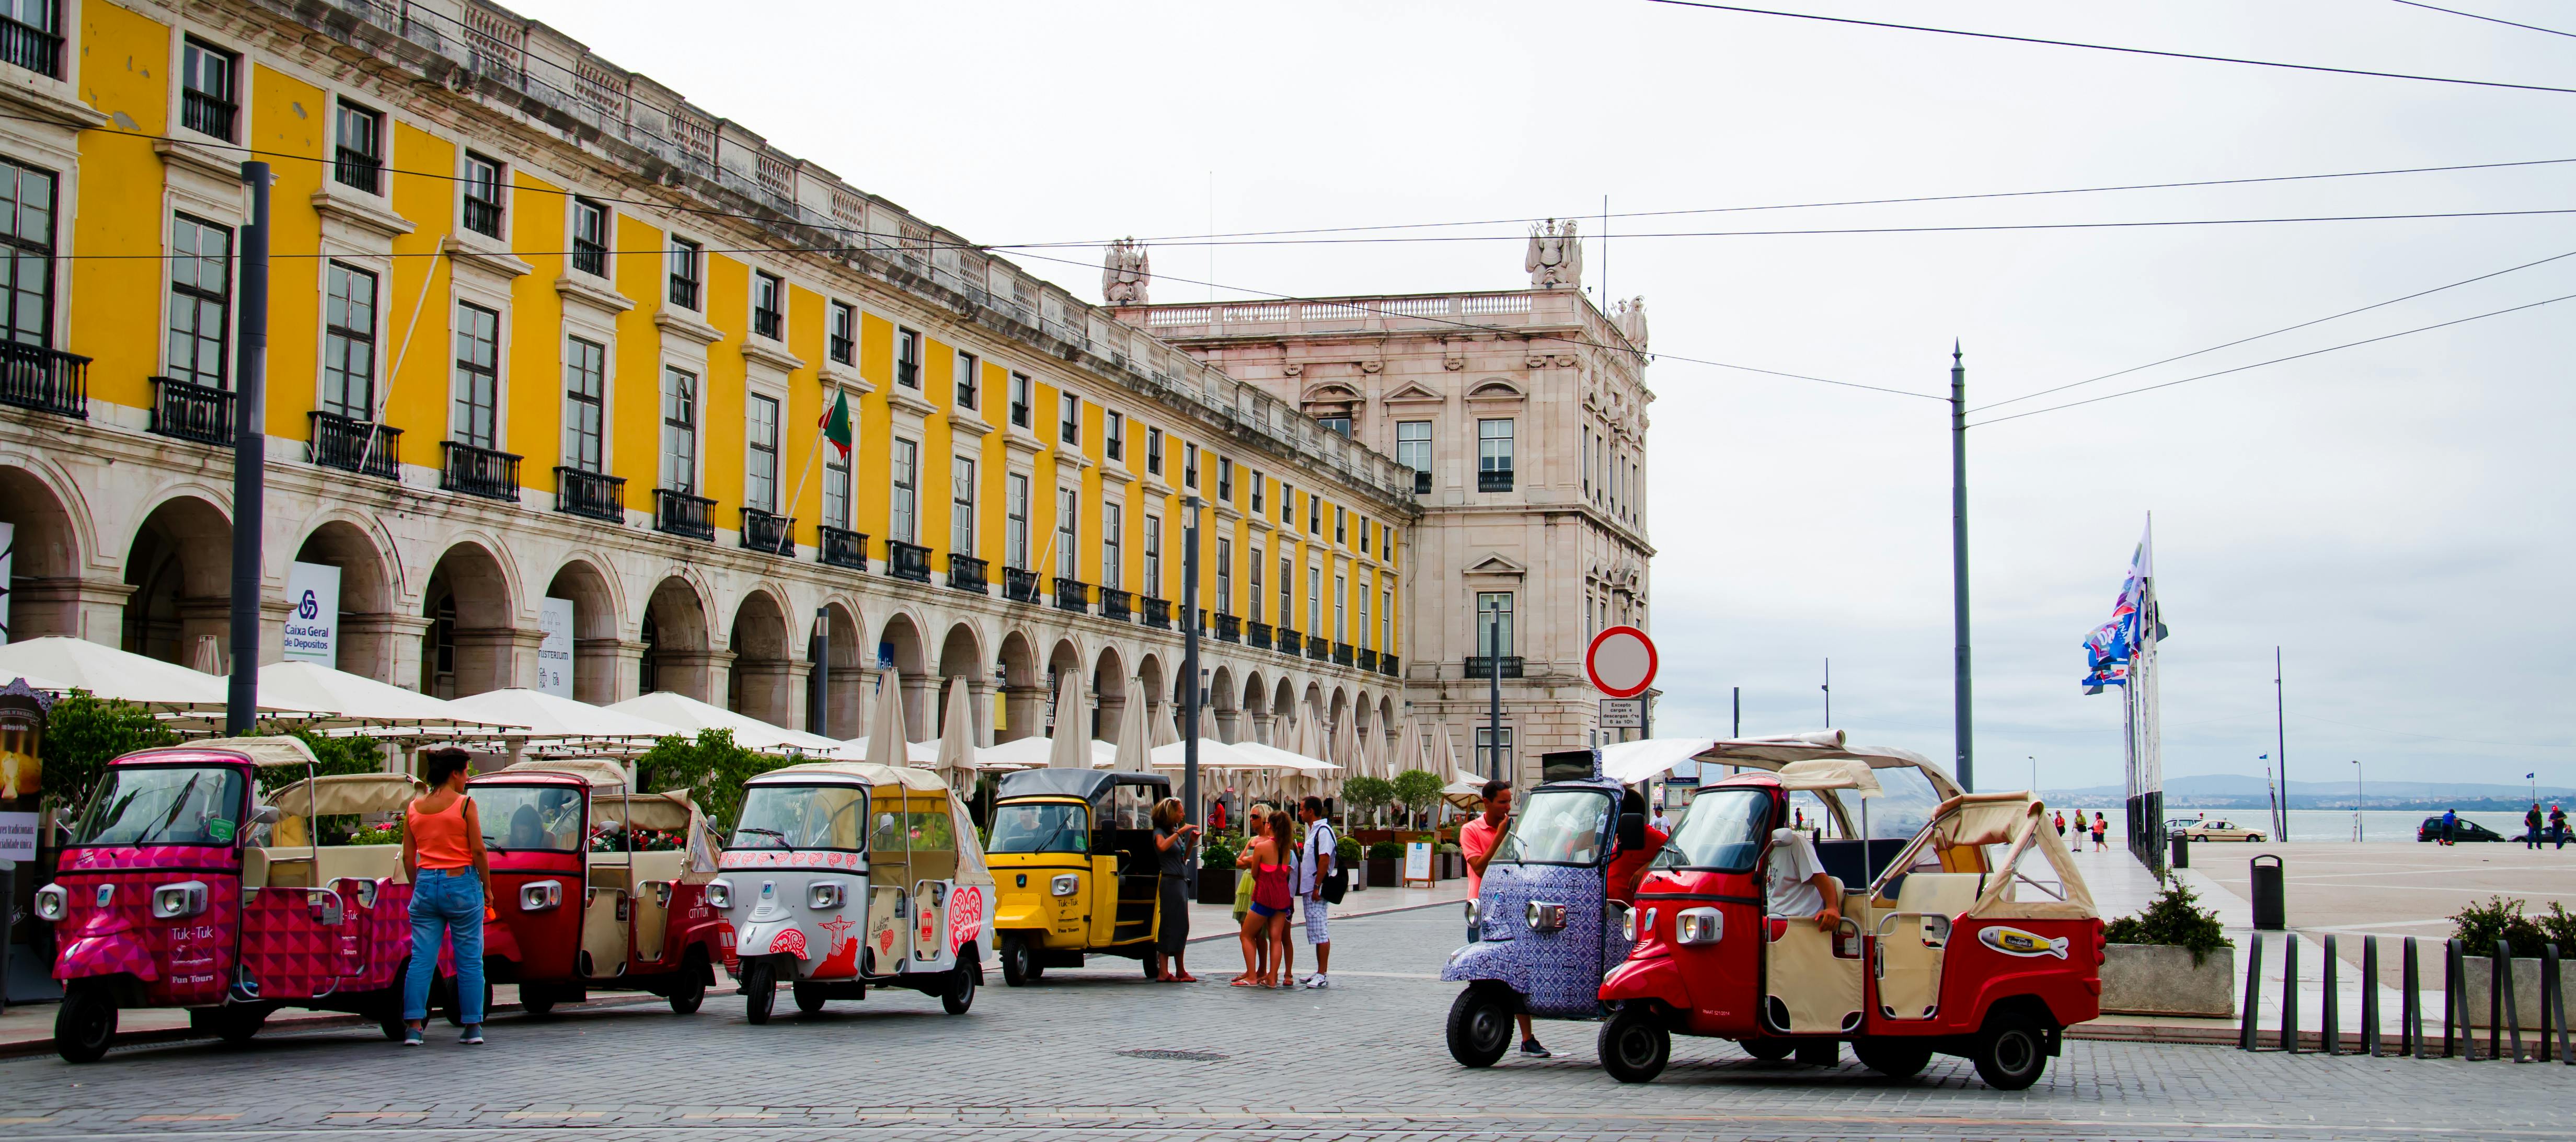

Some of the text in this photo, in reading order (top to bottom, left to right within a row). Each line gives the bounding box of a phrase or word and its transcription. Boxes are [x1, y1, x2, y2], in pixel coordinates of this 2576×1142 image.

[285, 624, 329, 638] Caixa Geral
[284, 638, 328, 650] de Depositos
[1058, 898, 1079, 907] Tuk-Tuk
[172, 925, 213, 940] Tuk-Tuk
